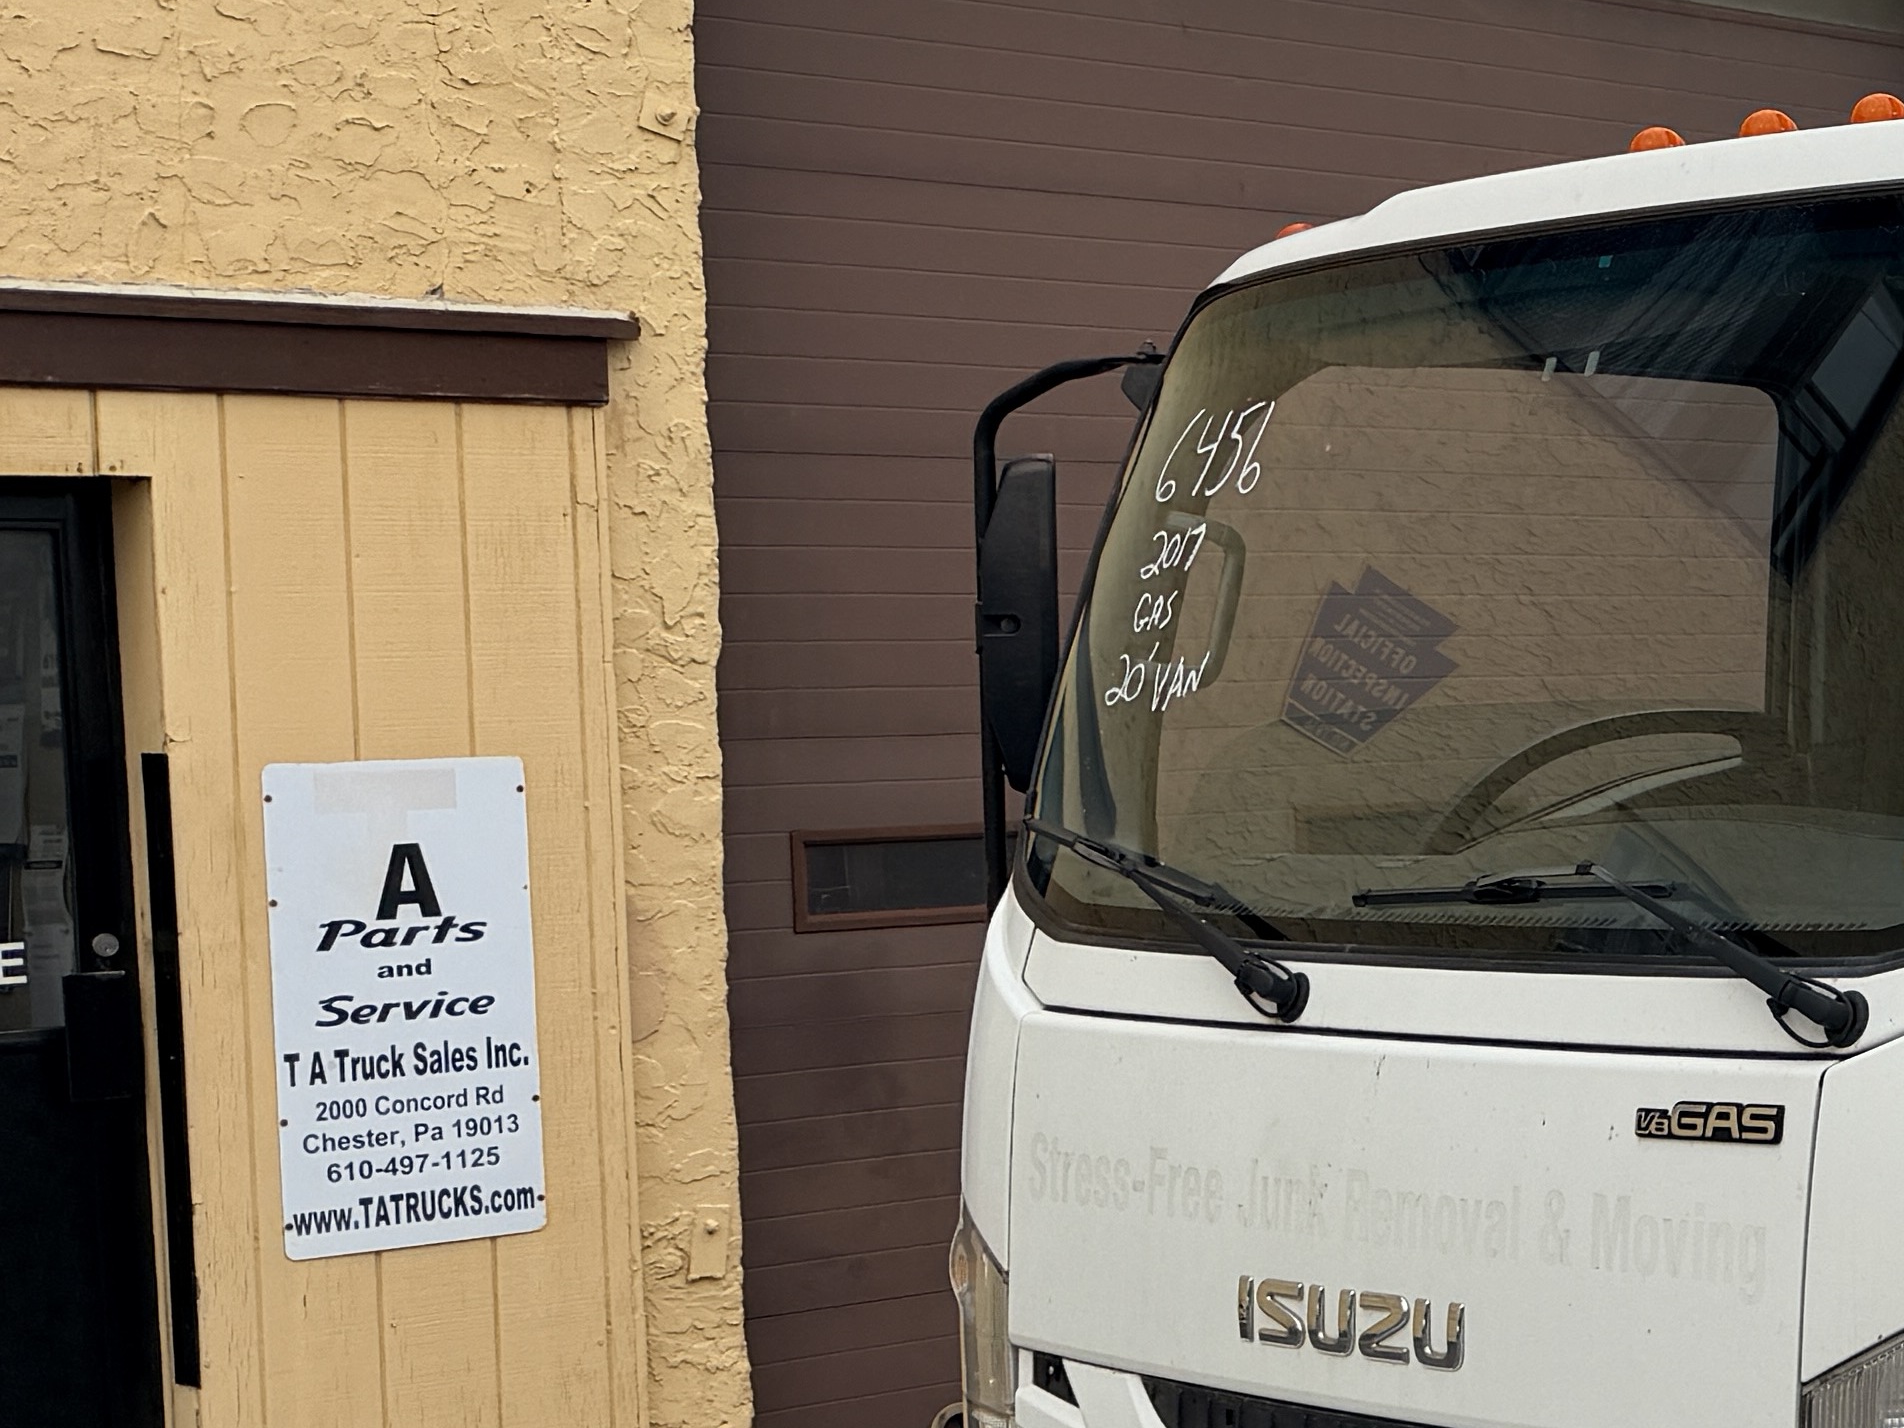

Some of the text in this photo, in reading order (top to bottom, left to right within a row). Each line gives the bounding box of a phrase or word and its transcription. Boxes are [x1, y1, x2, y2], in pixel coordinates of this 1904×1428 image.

[1154, 400, 1276, 502] 6456
[1140, 524, 1206, 580] 2017
[1134, 590, 1178, 633] GAS
[1152, 652, 1210, 712] VAN
[375, 842, 442, 921] A
[315, 915, 488, 953] Parts
[377, 958, 433, 979] and
[315, 990, 496, 1028] Service
[283, 1035, 529, 1087] T A Truck Sales Inc.
[315, 1084, 504, 1121] 2000 Concord Rd
[1670, 1102, 1777, 1141] GAS
[302, 1113, 520, 1155] Chester, Pa 19013
[326, 1145, 501, 1184] 610-497-1125
[293, 1183, 536, 1237] www.TATRUCKS.com
[1237, 1274, 1465, 1372] ISUZU
